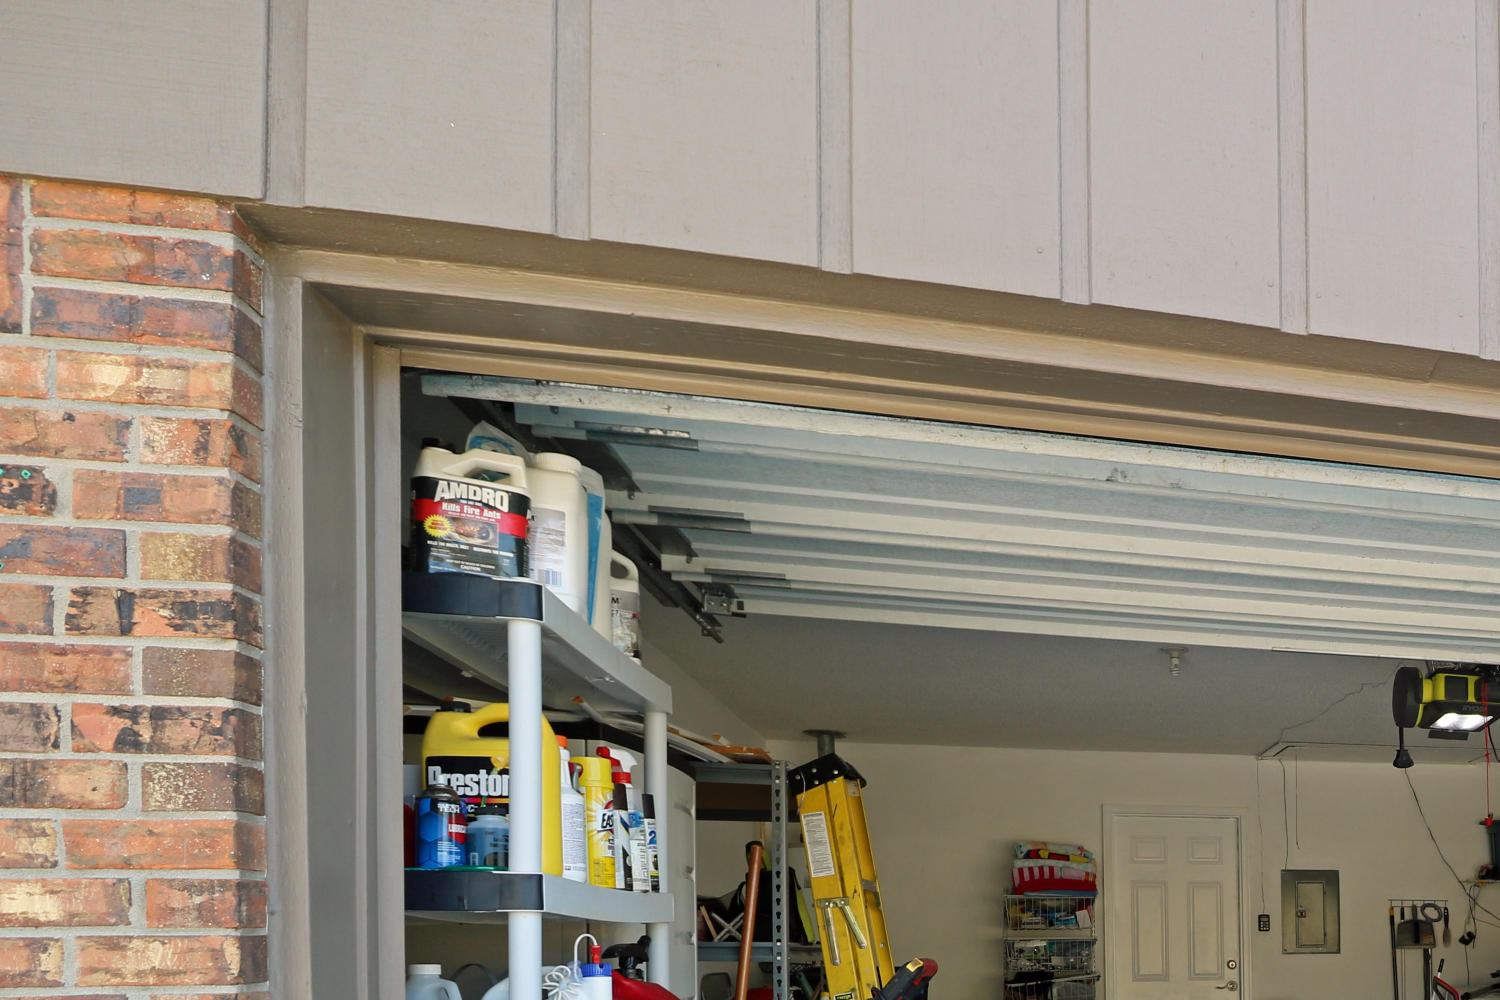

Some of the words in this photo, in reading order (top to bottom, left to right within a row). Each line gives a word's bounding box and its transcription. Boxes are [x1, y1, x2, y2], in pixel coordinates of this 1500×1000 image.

[434, 480, 510, 513] AMDRO
[442, 501, 460, 513] Kills
[463, 505, 480, 516] Fire
[483, 508, 501, 520] Ants
